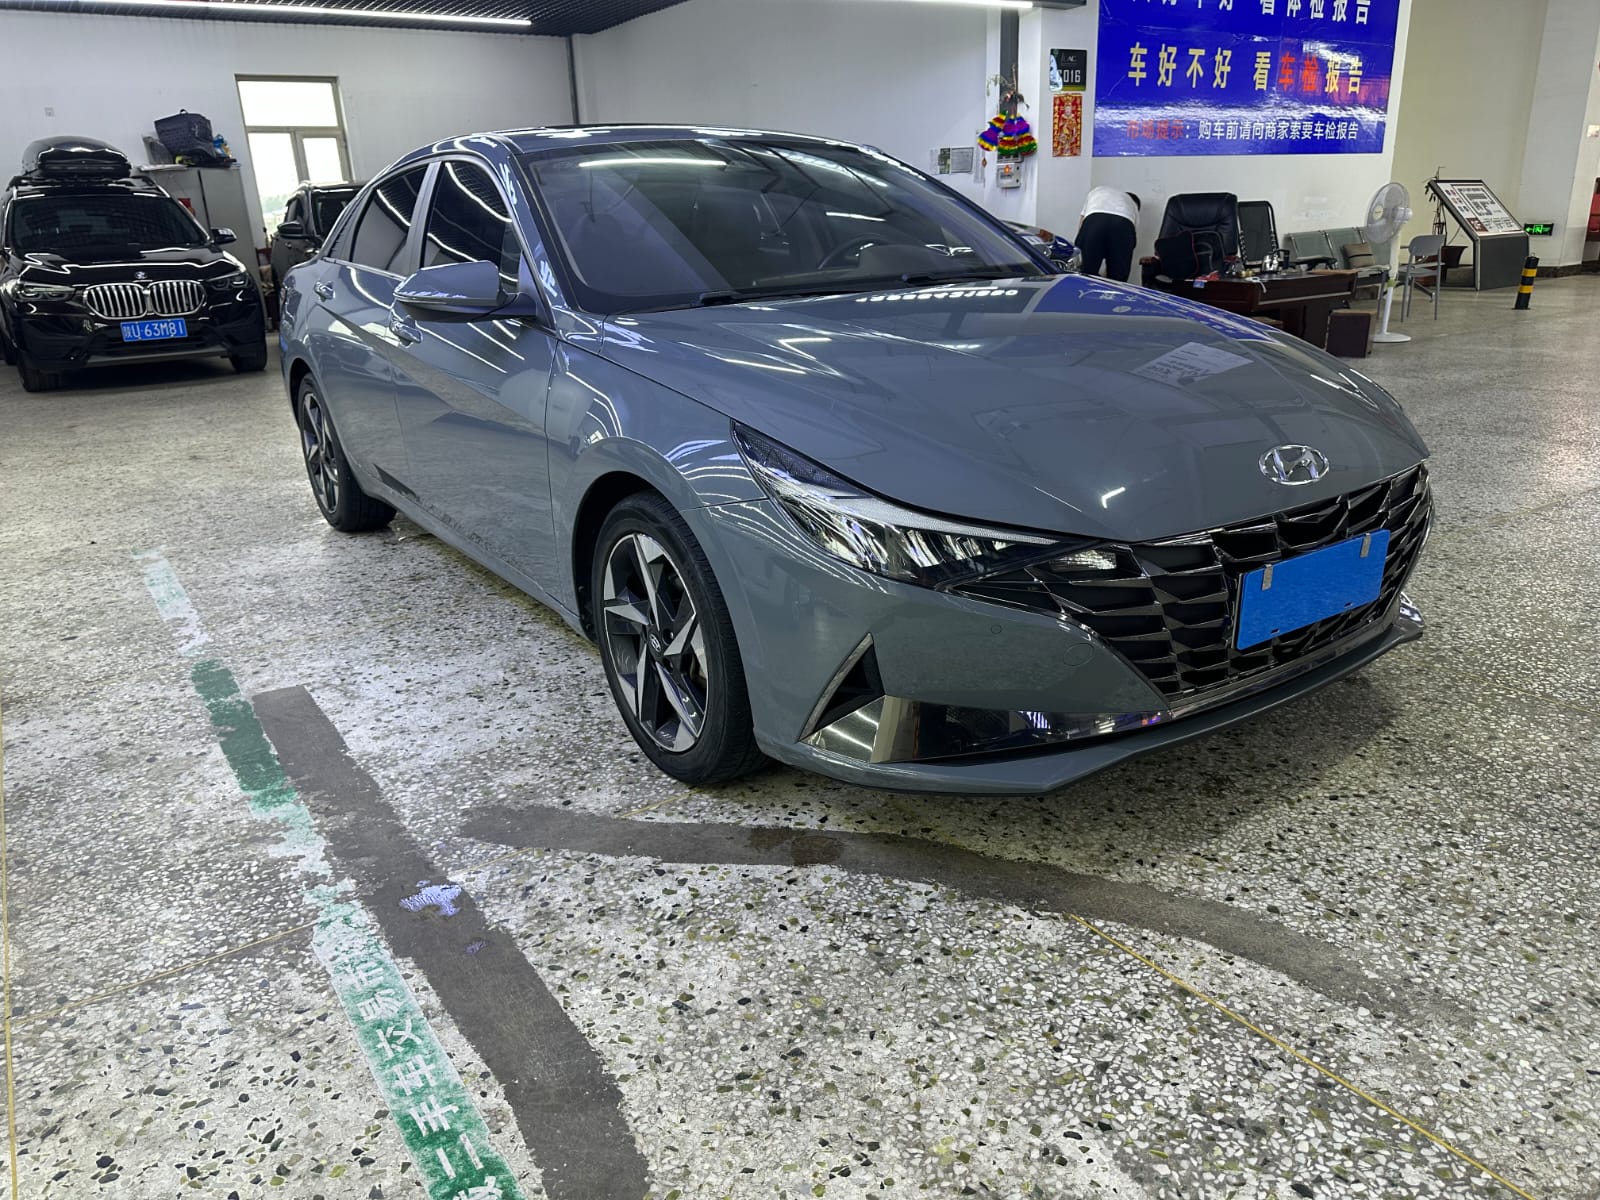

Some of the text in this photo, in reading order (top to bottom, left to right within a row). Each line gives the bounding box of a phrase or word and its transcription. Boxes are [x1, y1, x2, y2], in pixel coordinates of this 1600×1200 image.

[1128, 42, 1362, 93] 车好不好 看车检报告
